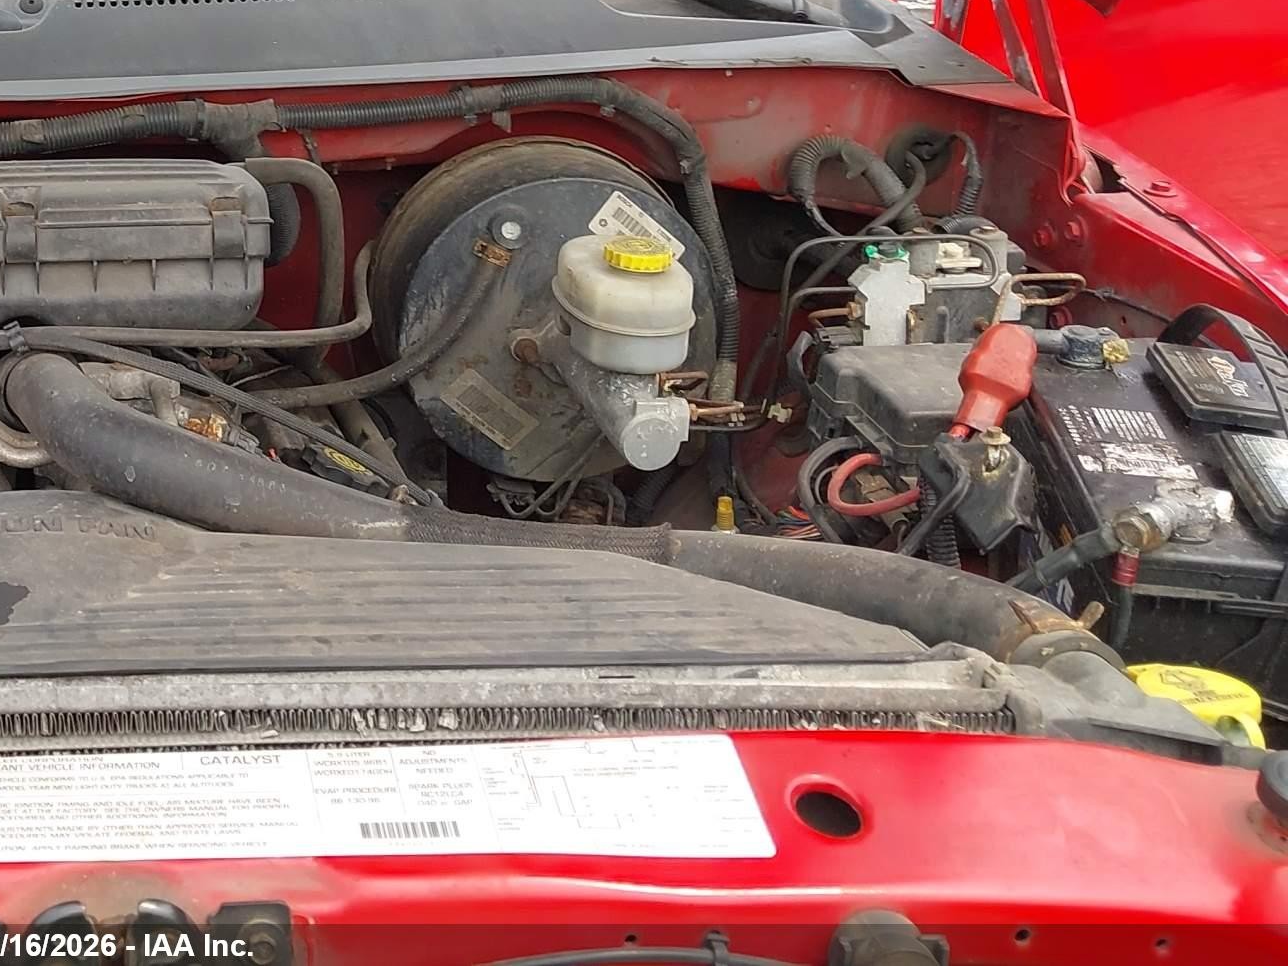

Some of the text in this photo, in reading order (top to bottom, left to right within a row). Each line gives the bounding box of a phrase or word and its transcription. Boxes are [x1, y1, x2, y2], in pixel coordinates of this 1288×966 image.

[78, 516, 160, 546] FAN
[200, 754, 280, 766] CATALYST
[28, 763, 73, 771] VEHICLE
[80, 762, 160, 770] INFORMATION
